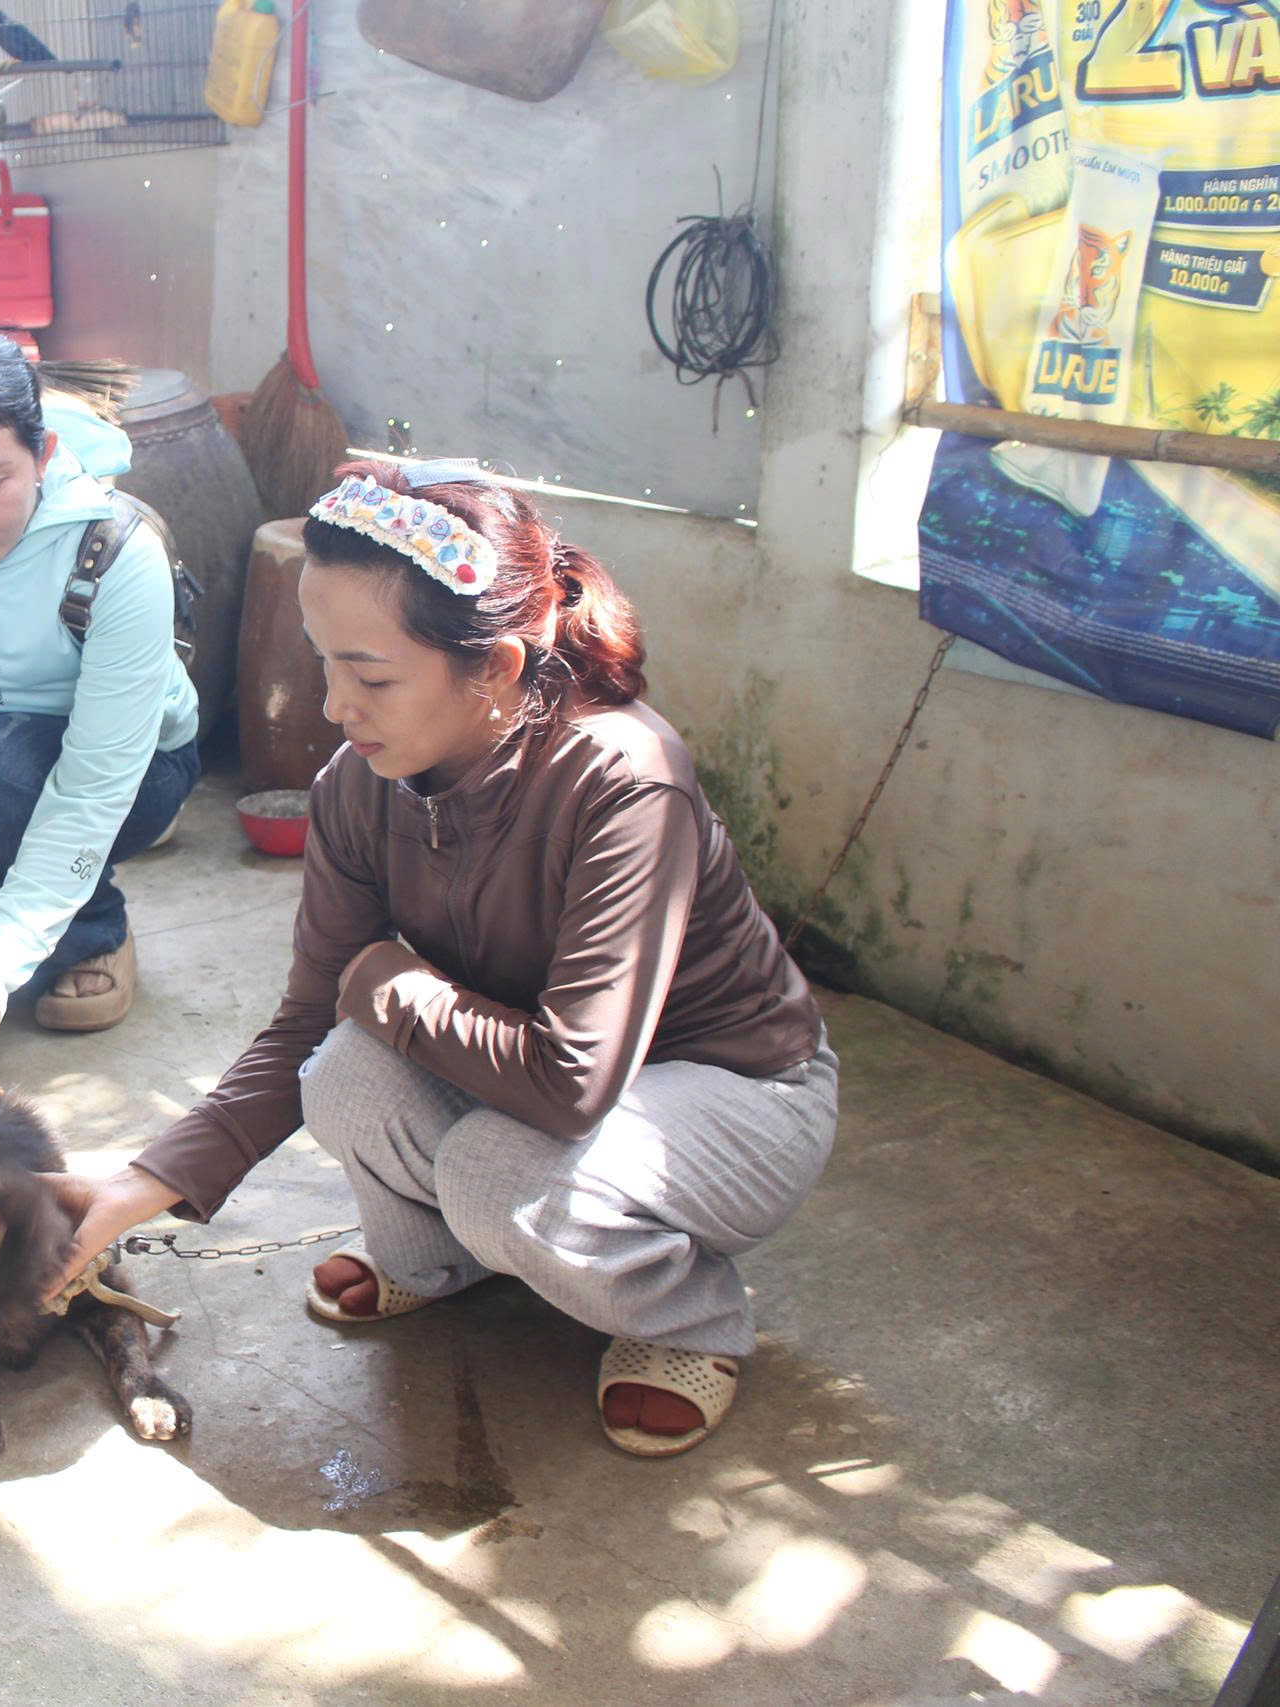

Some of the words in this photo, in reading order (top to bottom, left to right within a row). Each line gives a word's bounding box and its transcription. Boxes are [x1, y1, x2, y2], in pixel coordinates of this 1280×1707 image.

[1203, 177, 1237, 192] HÀNG
[1160, 249, 1189, 266] HÀNG
[1191, 255, 1222, 274] TRIỆU
[1224, 256, 1247, 273] GIẢI
